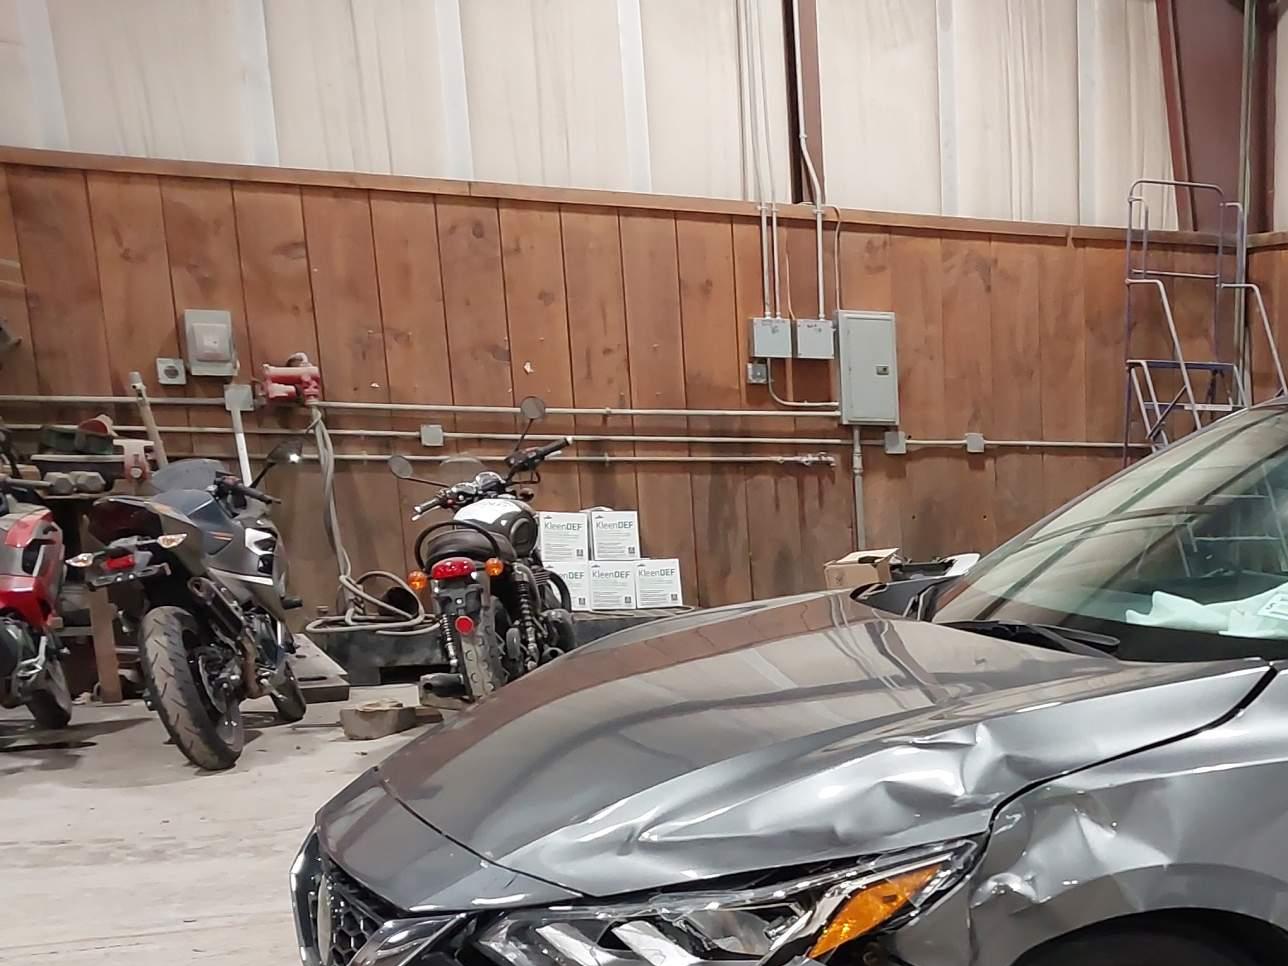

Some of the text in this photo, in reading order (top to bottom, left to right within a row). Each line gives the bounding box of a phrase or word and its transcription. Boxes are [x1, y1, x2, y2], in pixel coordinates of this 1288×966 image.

[544, 521, 582, 531] KleenDEF
[596, 520, 633, 530] KleenDEF
[592, 569, 631, 579] KleenDEF
[638, 568, 675, 577] KleenDEF
